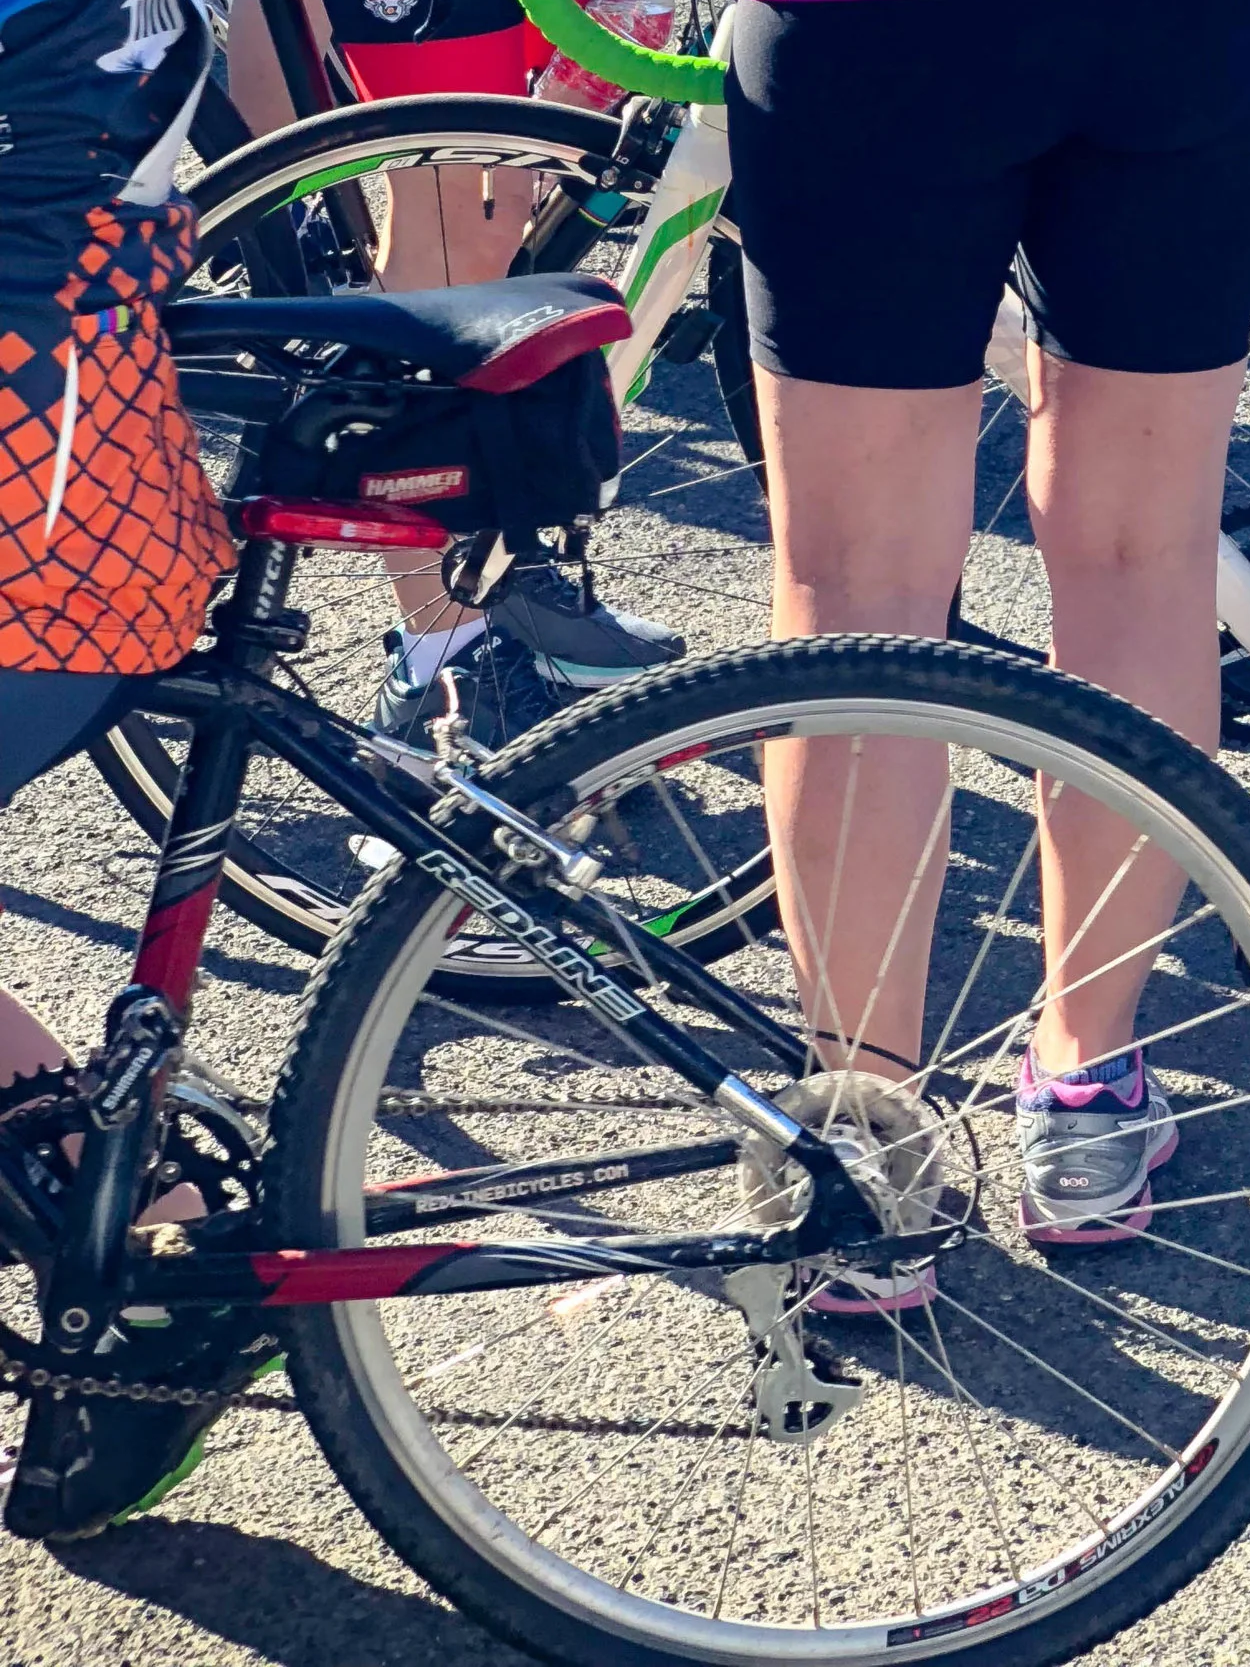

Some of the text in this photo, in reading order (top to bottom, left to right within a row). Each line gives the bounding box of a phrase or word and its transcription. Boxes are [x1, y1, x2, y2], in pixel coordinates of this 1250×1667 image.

[365, 470, 464, 497] HAMMER
[416, 849, 647, 1022] REDLINE
[414, 1163, 630, 1215] REDLINEBICYCLES.COM
